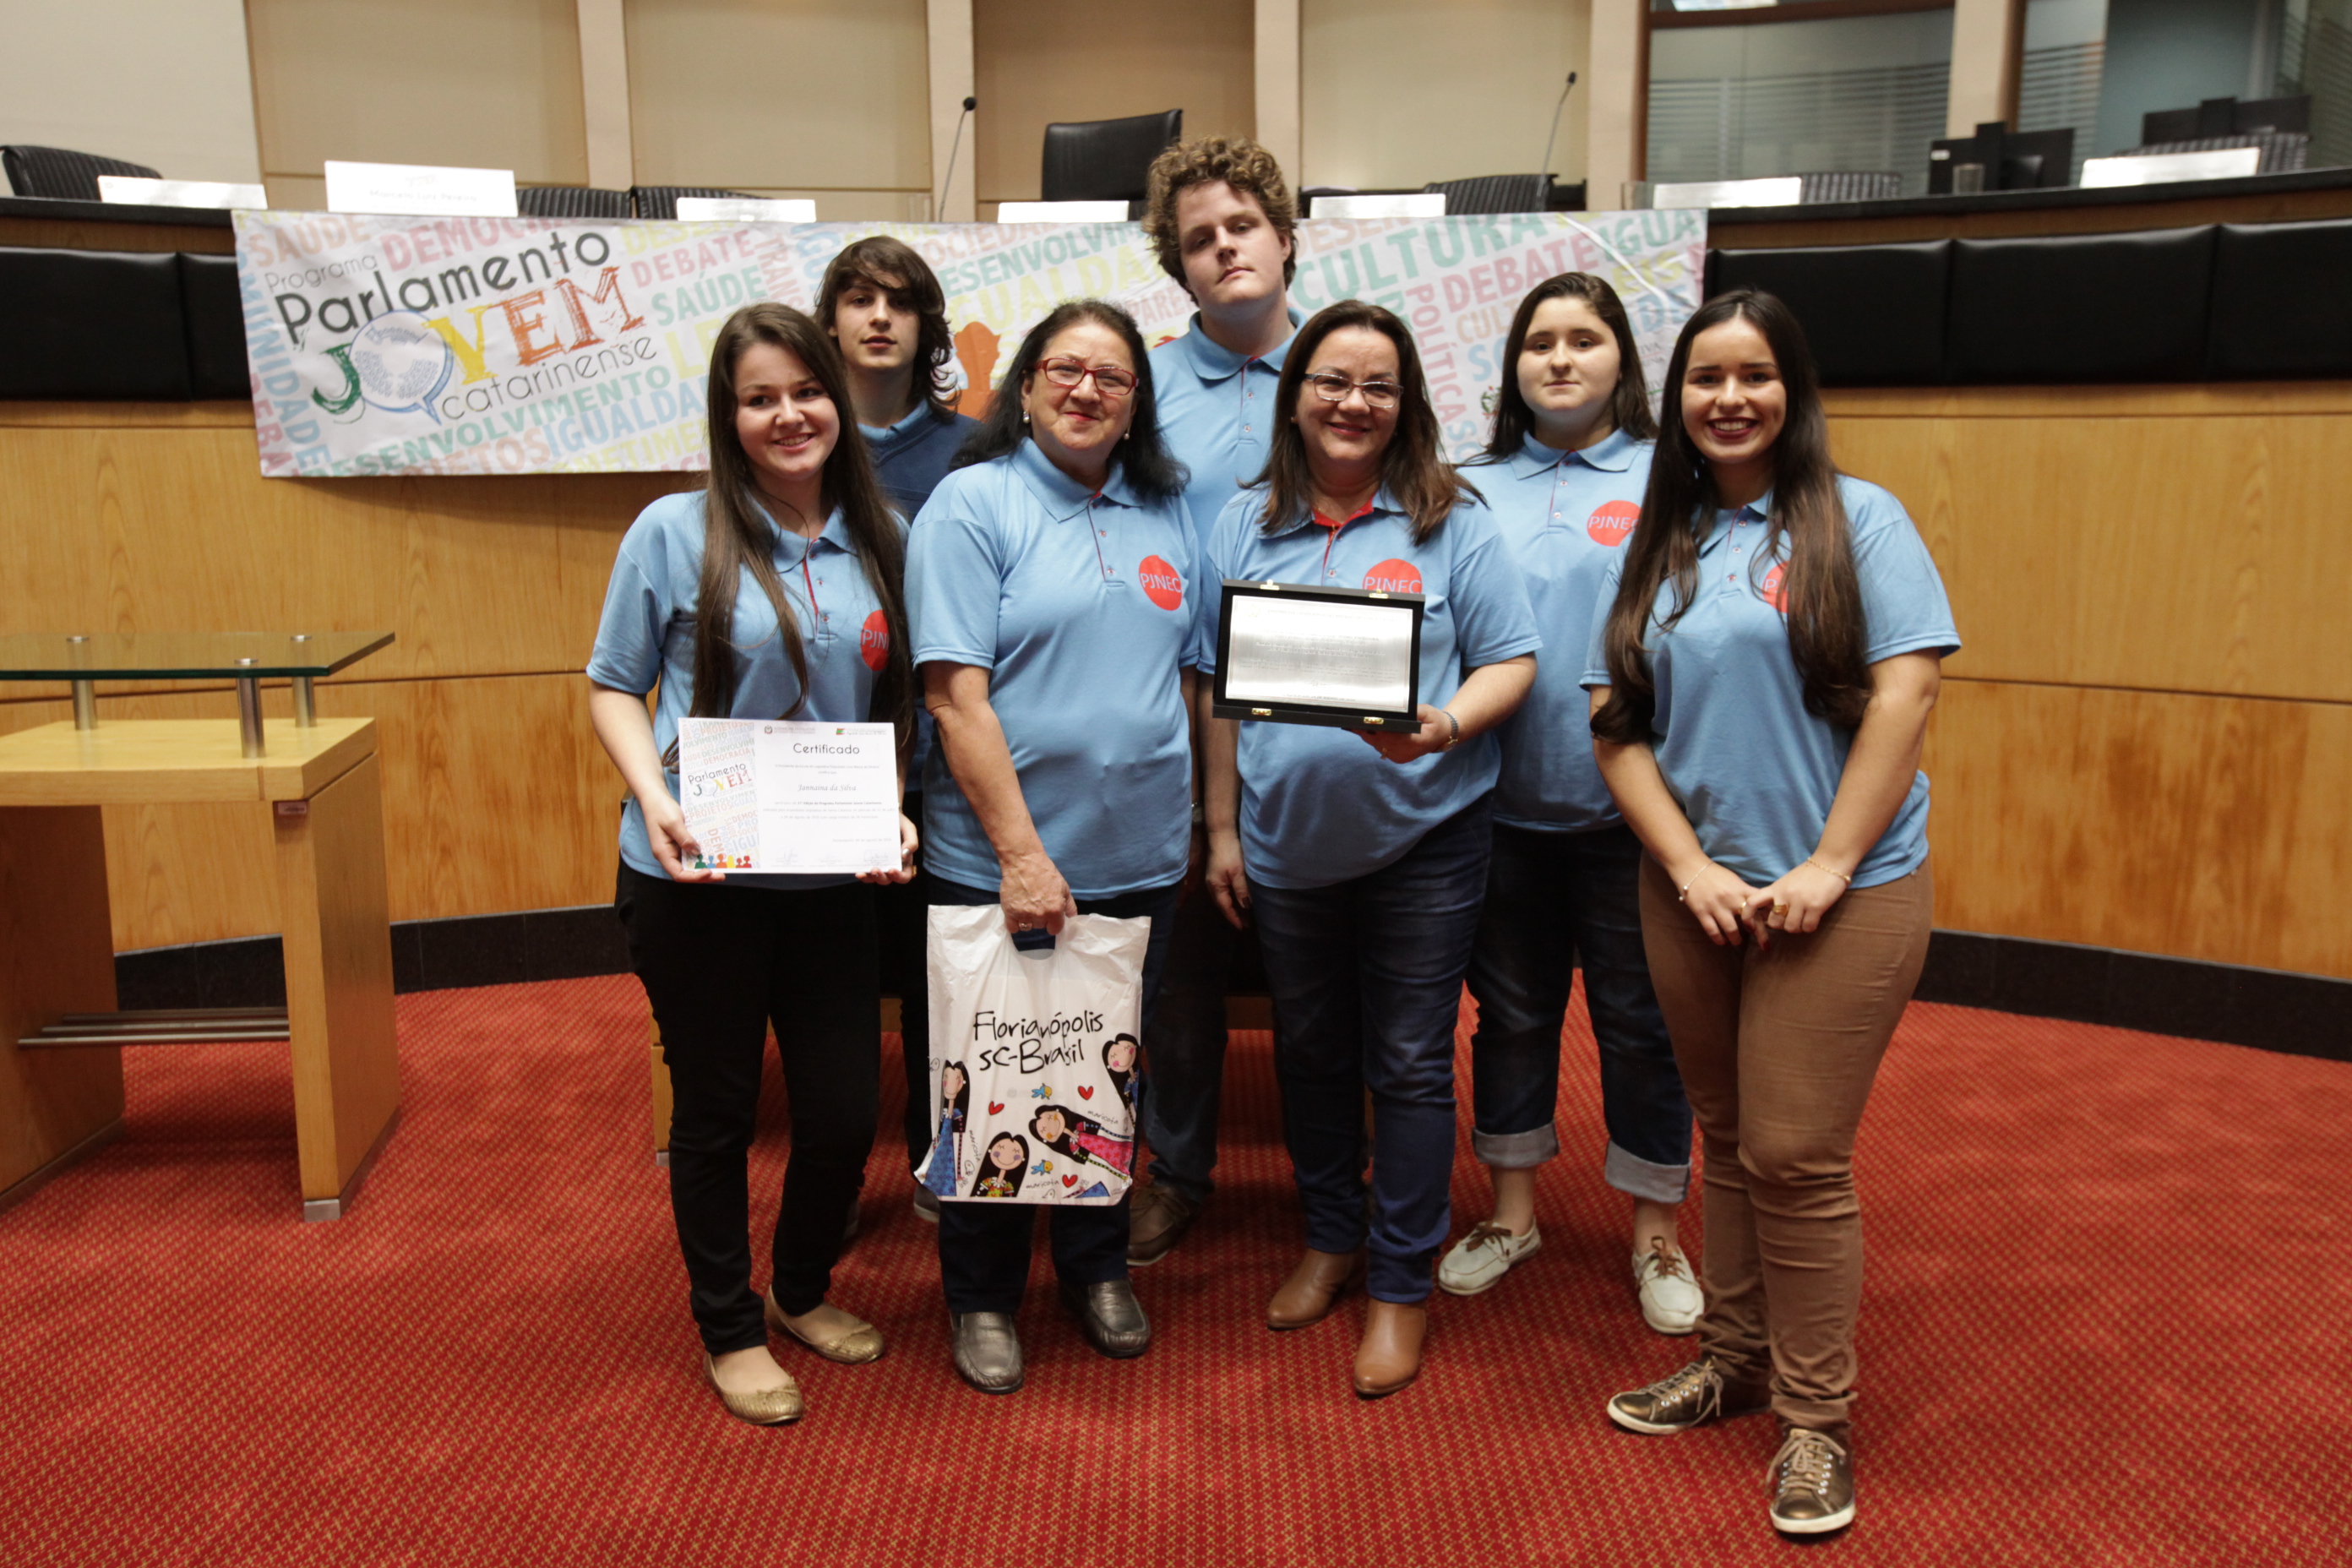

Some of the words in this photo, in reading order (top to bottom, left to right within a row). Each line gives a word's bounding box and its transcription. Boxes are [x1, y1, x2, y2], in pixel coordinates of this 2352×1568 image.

[264, 253, 378, 294] Programa
[630, 229, 755, 288] DEBATE
[1292, 213, 1549, 311] CULTURA
[1441, 231, 1599, 313] DEBATE
[275, 231, 611, 346] Parlamento
[651, 264, 767, 326] SAÚDE
[1405, 282, 1467, 425] POLÍTICA
[441, 336, 657, 421] catarinense
[703, 747, 751, 765] DEMOCRACIA
[792, 743, 860, 754] Certificado
[688, 763, 746, 784] Parlamento
[797, 783, 828, 792] Jannaina
[973, 1010, 1104, 1048] Florianópolis
[1087, 1110, 1119, 1125] maricota
[969, 1130, 982, 1162] maricota
[1026, 1179, 1060, 1190] maricota
